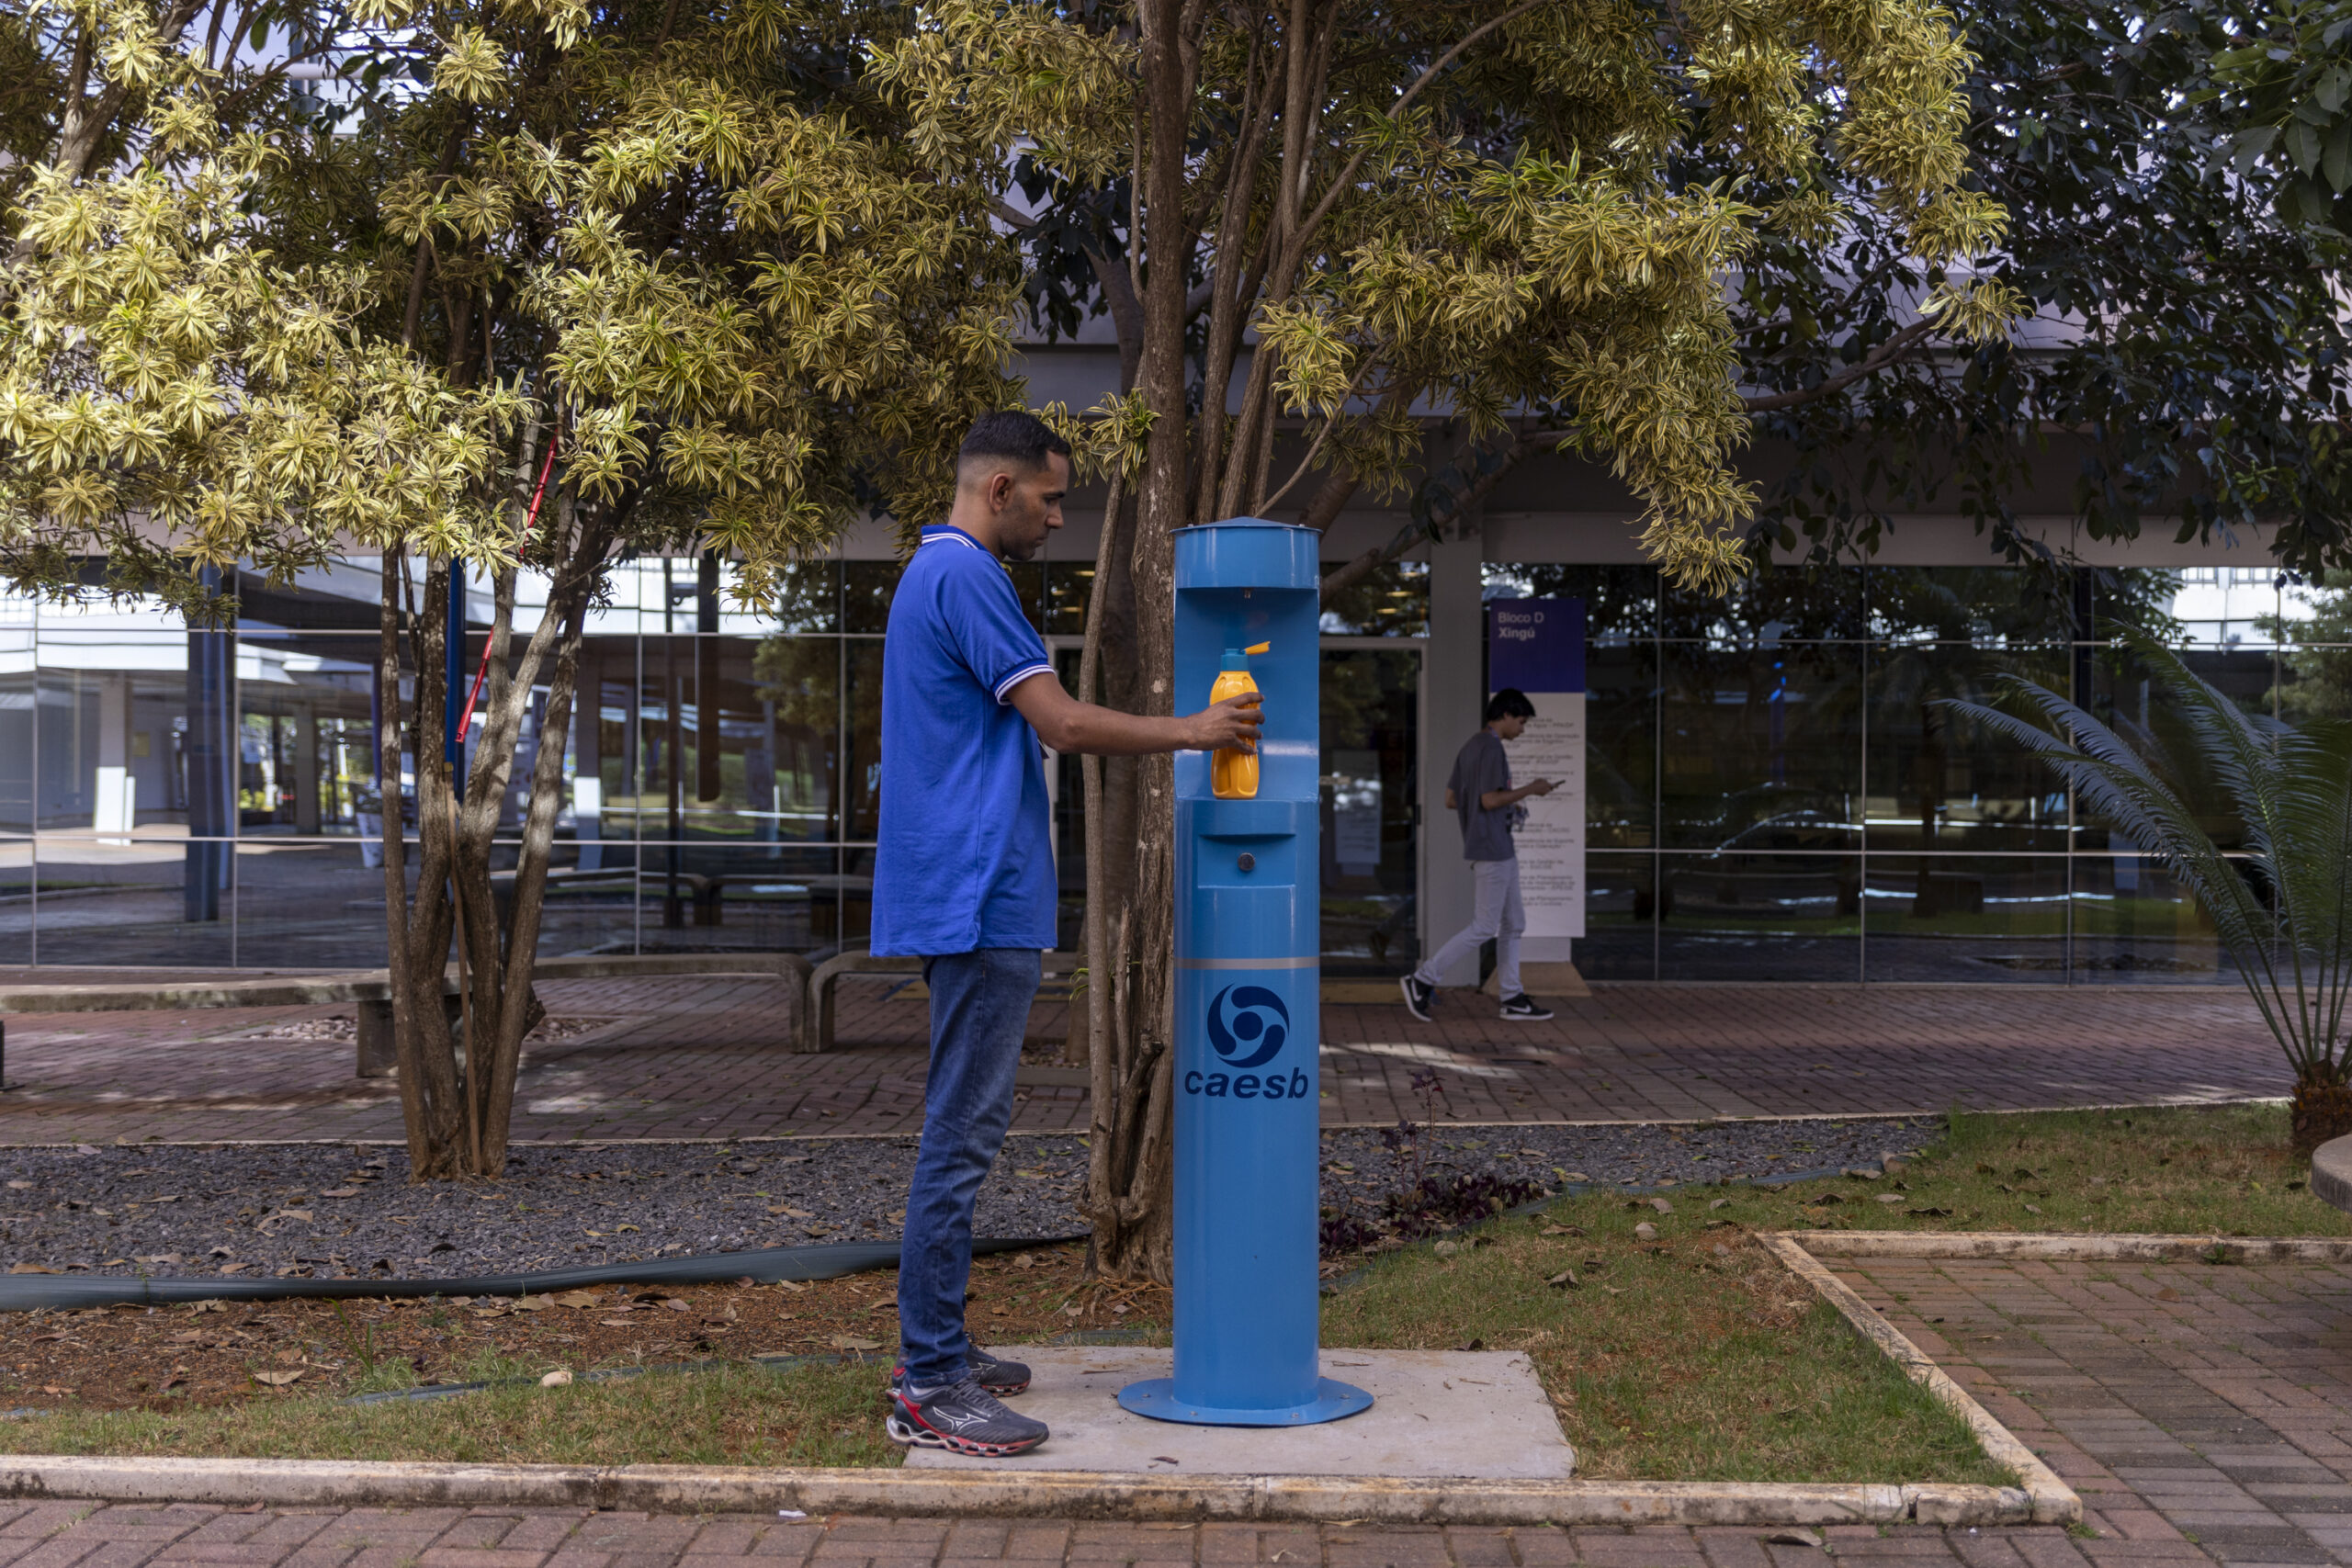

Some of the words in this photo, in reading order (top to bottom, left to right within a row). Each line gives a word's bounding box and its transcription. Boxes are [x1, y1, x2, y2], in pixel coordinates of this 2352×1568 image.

[1498, 612, 1531, 624] Bloco
[1534, 612, 1544, 624] D
[1498, 626, 1535, 641] Xingú
[1184, 1066, 1309, 1100] caesb
